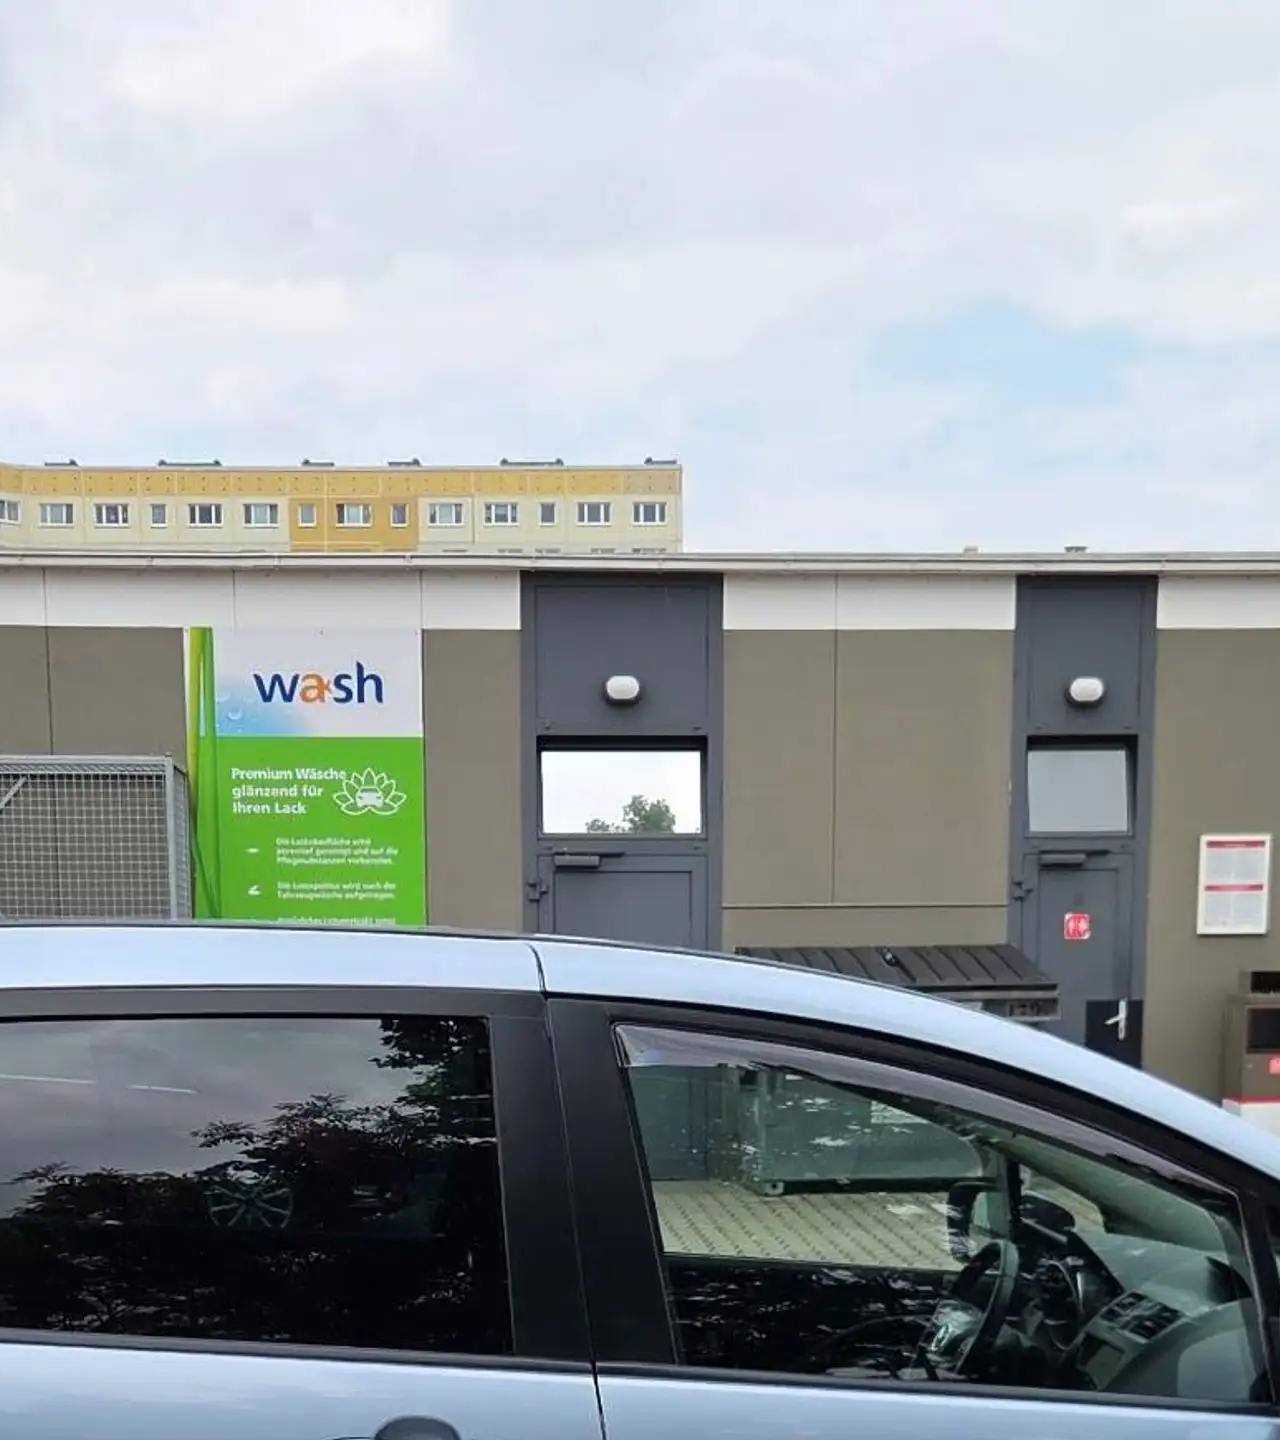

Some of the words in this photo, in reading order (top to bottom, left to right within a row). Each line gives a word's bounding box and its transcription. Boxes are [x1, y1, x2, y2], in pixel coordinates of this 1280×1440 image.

[252, 662, 384, 704] wash
[230, 767, 293, 781] Premium
[231, 784, 299, 800] glänzend
[301, 784, 325, 798] für
[232, 801, 272, 815] Ihren
[274, 801, 308, 815] Lack
